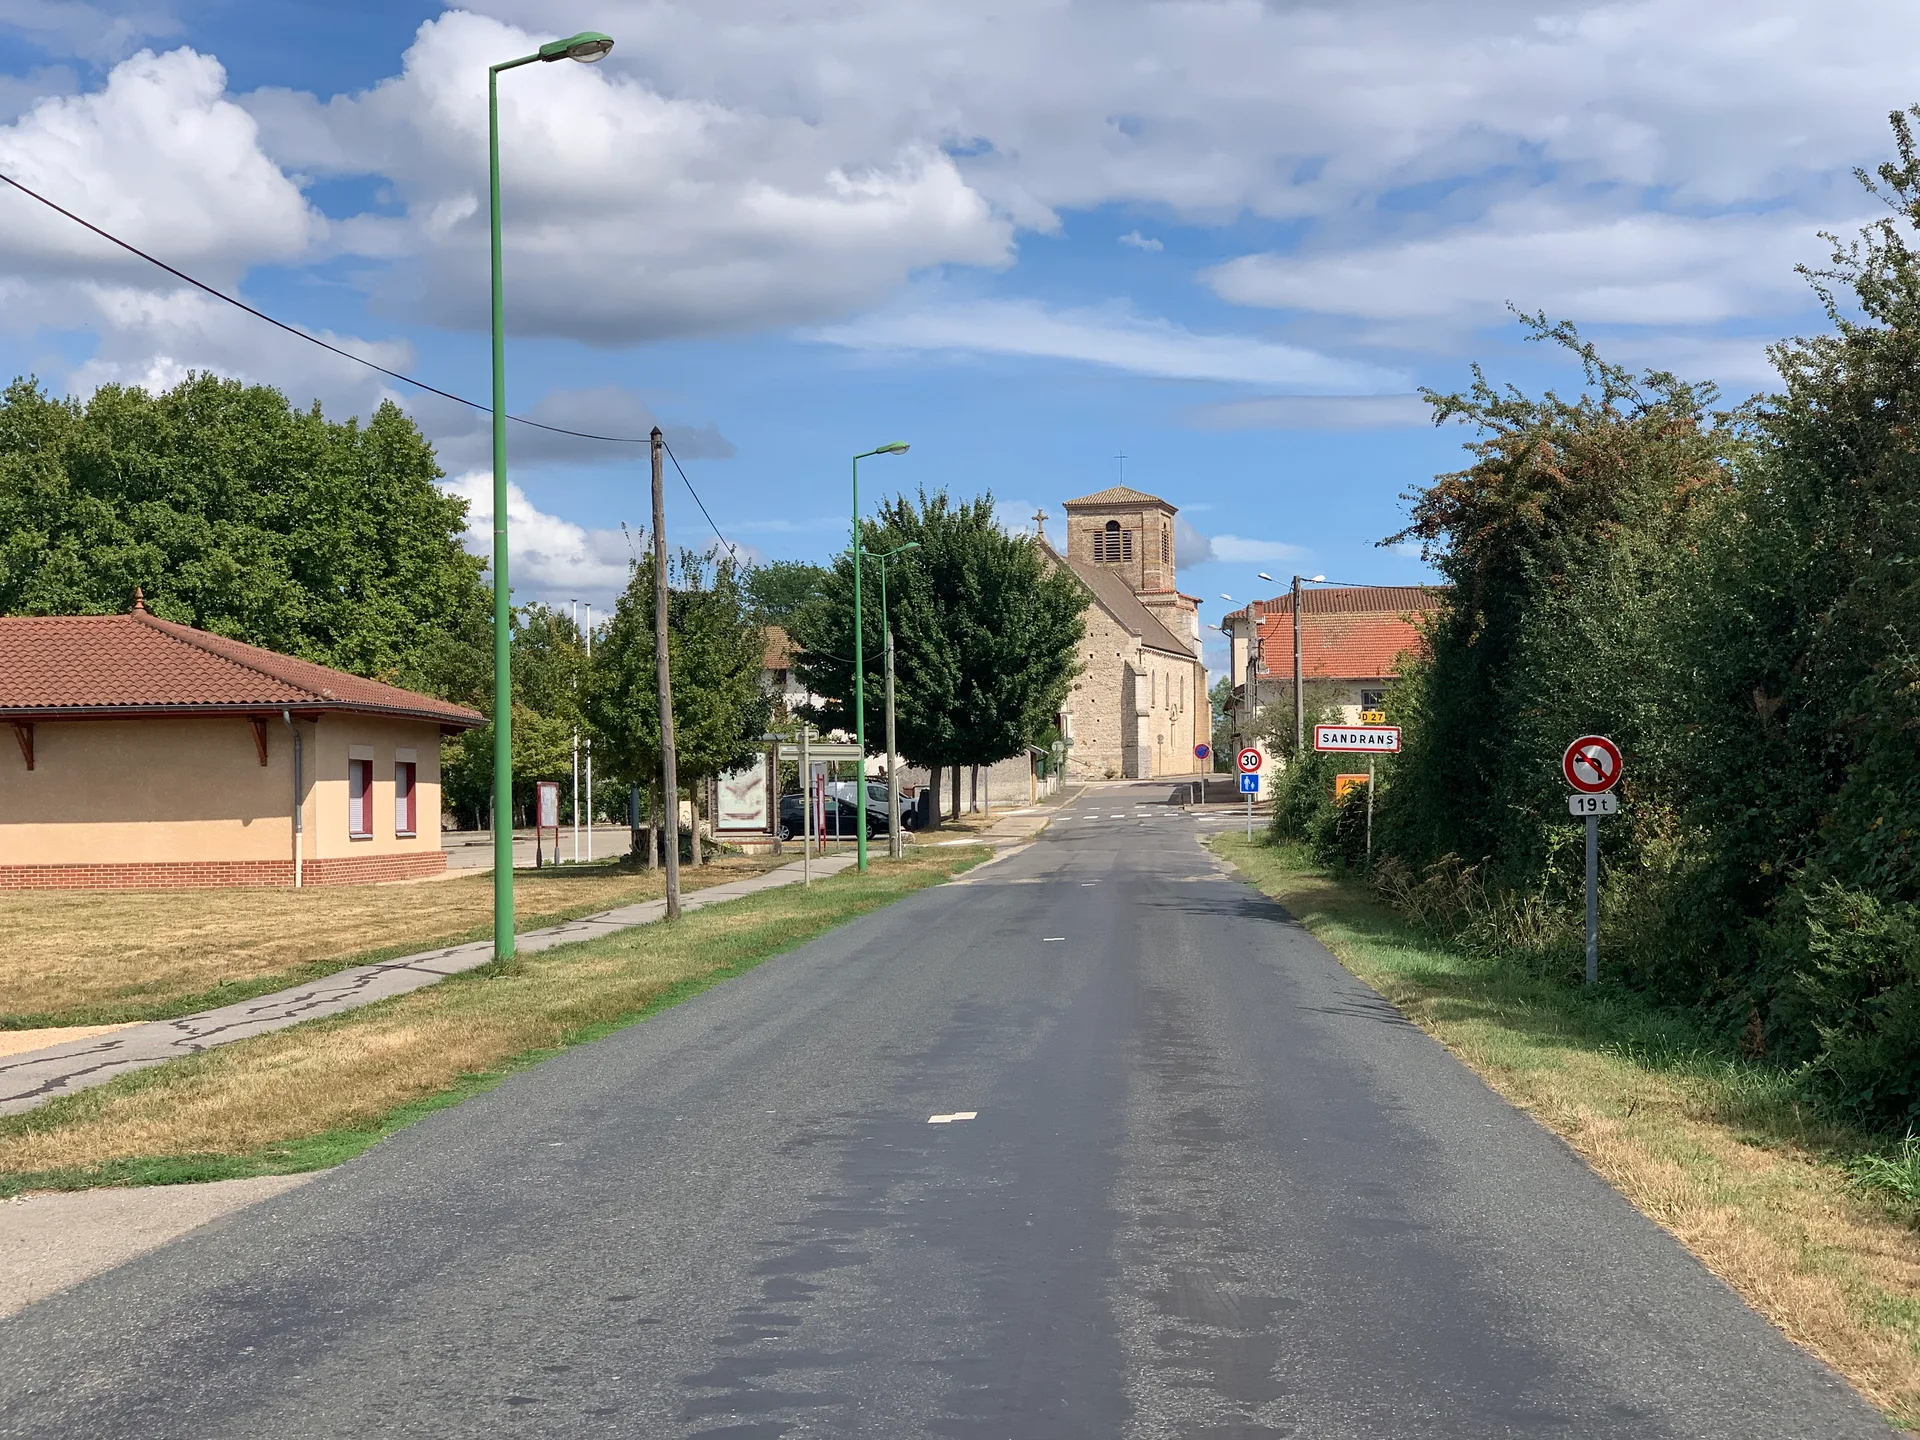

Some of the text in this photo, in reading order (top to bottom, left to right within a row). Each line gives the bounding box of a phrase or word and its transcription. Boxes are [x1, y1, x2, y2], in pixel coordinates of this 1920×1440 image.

[1362, 713, 1383, 721] D 27
[1322, 733, 1394, 745] SANDRANS
[1242, 755, 1258, 766] 30
[1577, 797, 1609, 812] 19 t
